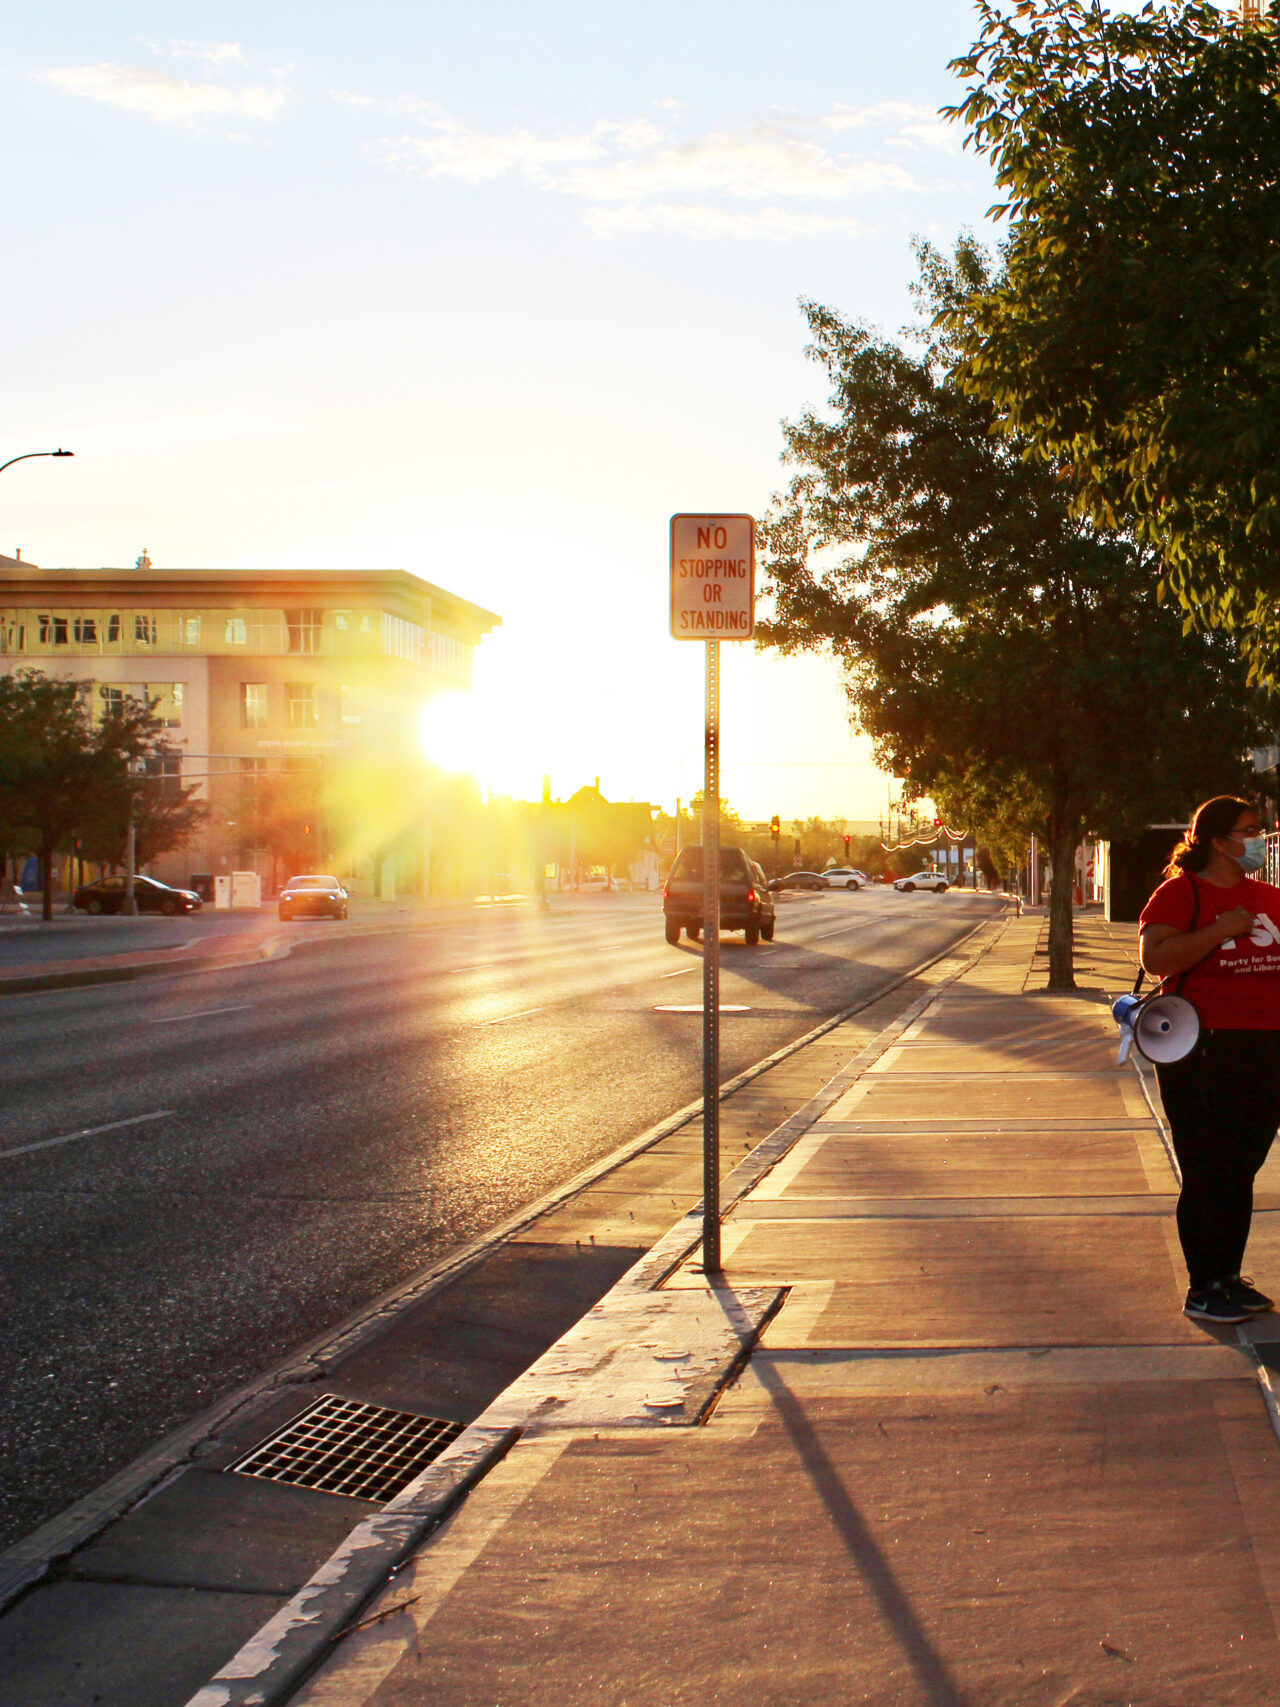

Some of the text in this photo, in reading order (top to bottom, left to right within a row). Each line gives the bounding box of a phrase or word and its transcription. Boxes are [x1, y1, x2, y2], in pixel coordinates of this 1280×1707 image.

[697, 526, 727, 549] NO
[679, 559, 746, 578] STOPPING
[703, 584, 722, 602] OR
[680, 610, 748, 630] STANDING
[1220, 958, 1249, 967] Party
